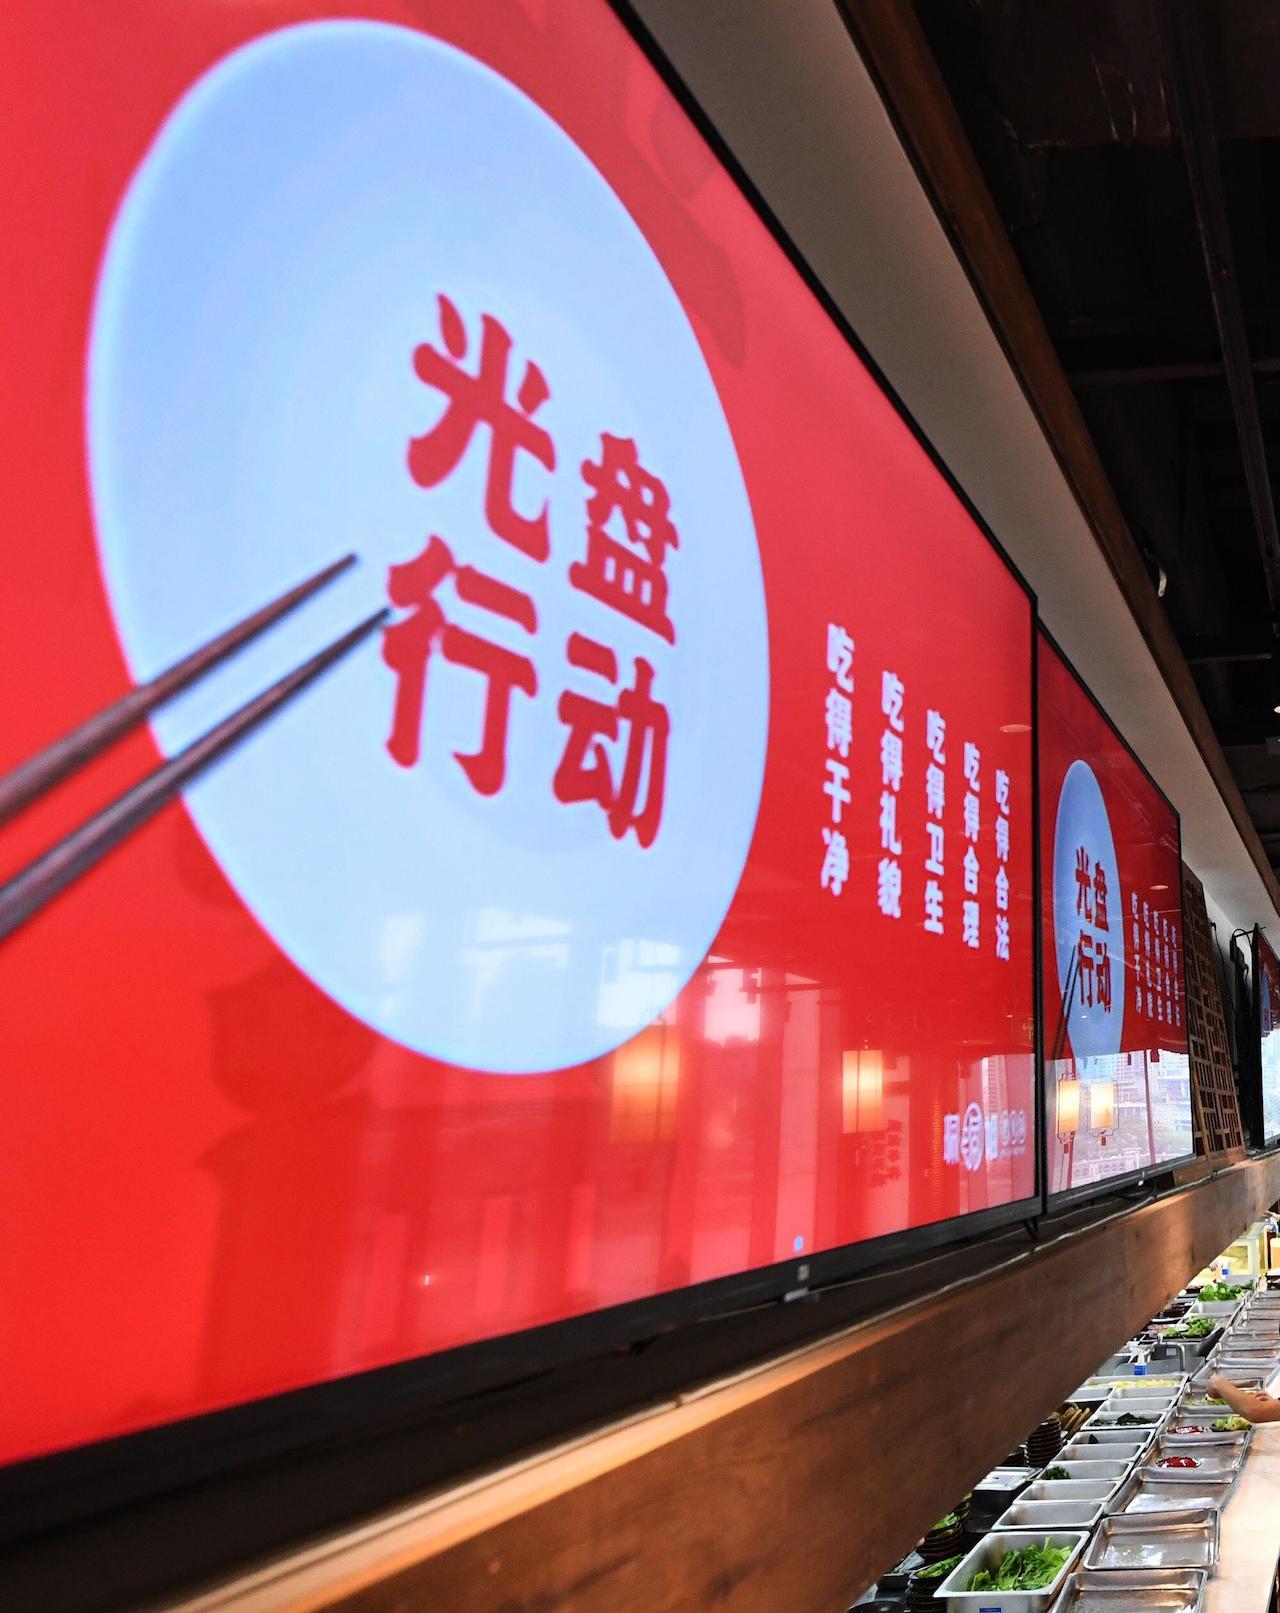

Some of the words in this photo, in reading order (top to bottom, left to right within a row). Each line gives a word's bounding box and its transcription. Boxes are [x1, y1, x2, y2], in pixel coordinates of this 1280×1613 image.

[406, 292, 679, 645] 光盘
[381, 534, 671, 849] 行动
[821, 622, 855, 896] 吃得干净
[924, 709, 945, 935] 吃得卫生
[1076, 846, 1110, 932] 光盘
[1078, 929, 1112, 1013] 行动
